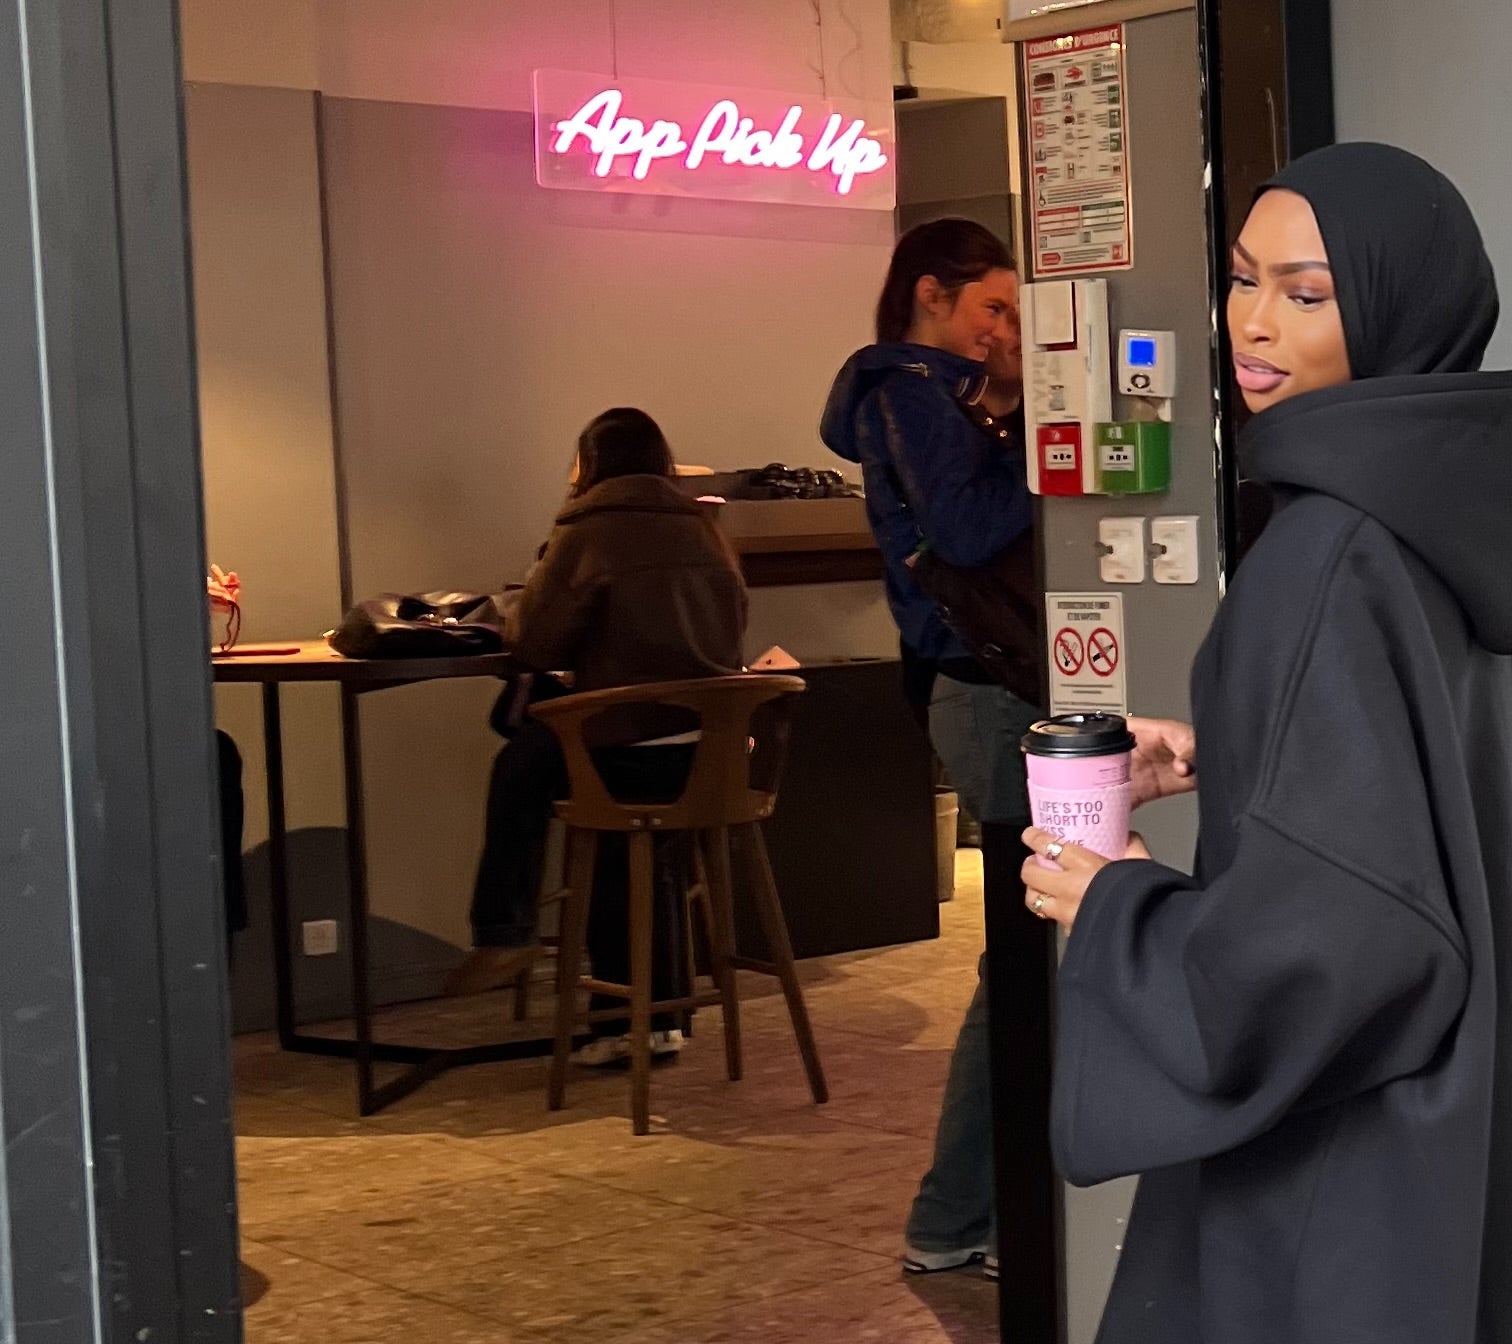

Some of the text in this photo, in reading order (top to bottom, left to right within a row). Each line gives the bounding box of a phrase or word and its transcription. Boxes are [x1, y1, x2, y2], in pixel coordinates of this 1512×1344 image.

[552, 89, 888, 194] App Pick Up
[1038, 800, 1104, 814] LIFE'S TOO
[1039, 813, 1101, 827] SHORT TO
